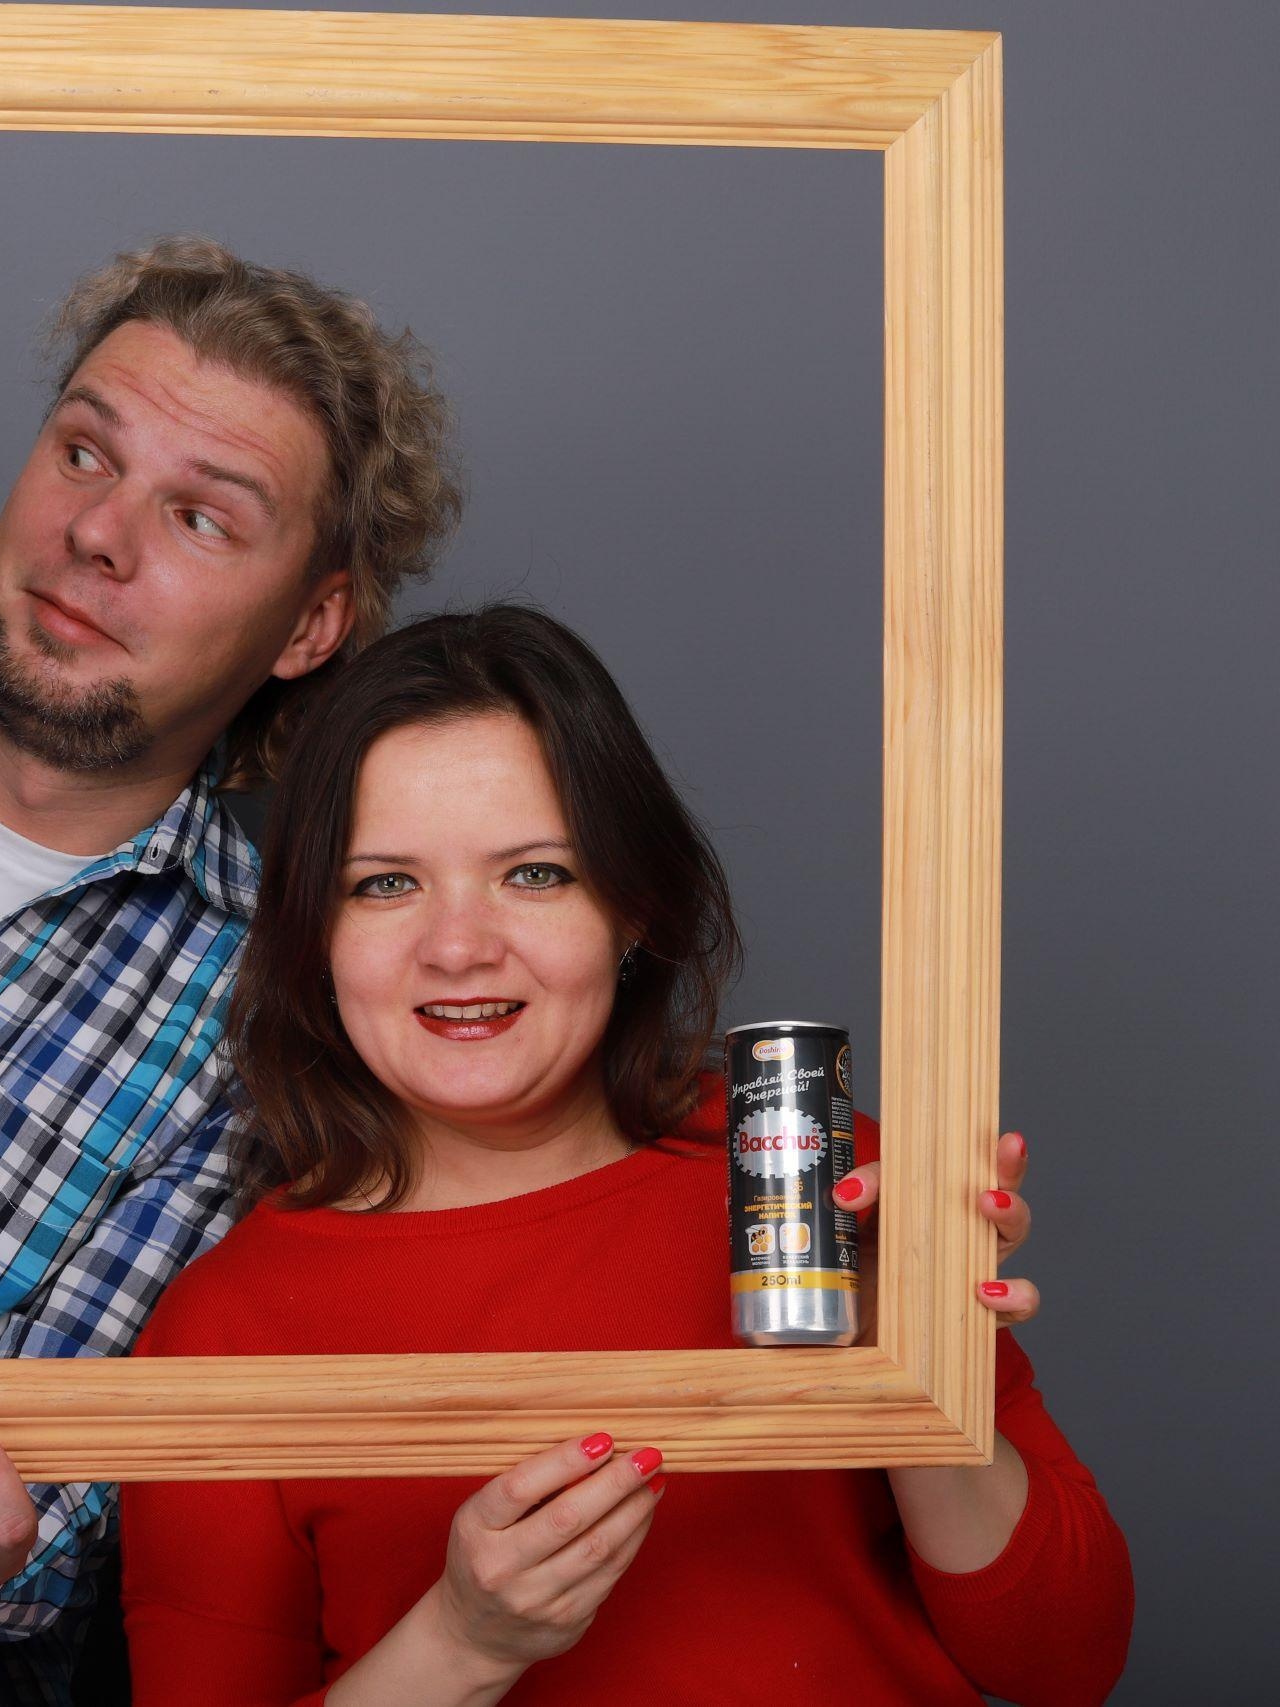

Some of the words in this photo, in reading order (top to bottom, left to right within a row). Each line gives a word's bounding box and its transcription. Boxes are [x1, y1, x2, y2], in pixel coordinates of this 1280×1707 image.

[732, 1072, 785, 1099] Управляй
[787, 1067, 825, 1081] Своей
[745, 1080, 810, 1104] Энергией!
[739, 1126, 821, 1154] Bacchus
[761, 1274, 802, 1287] 250ml
